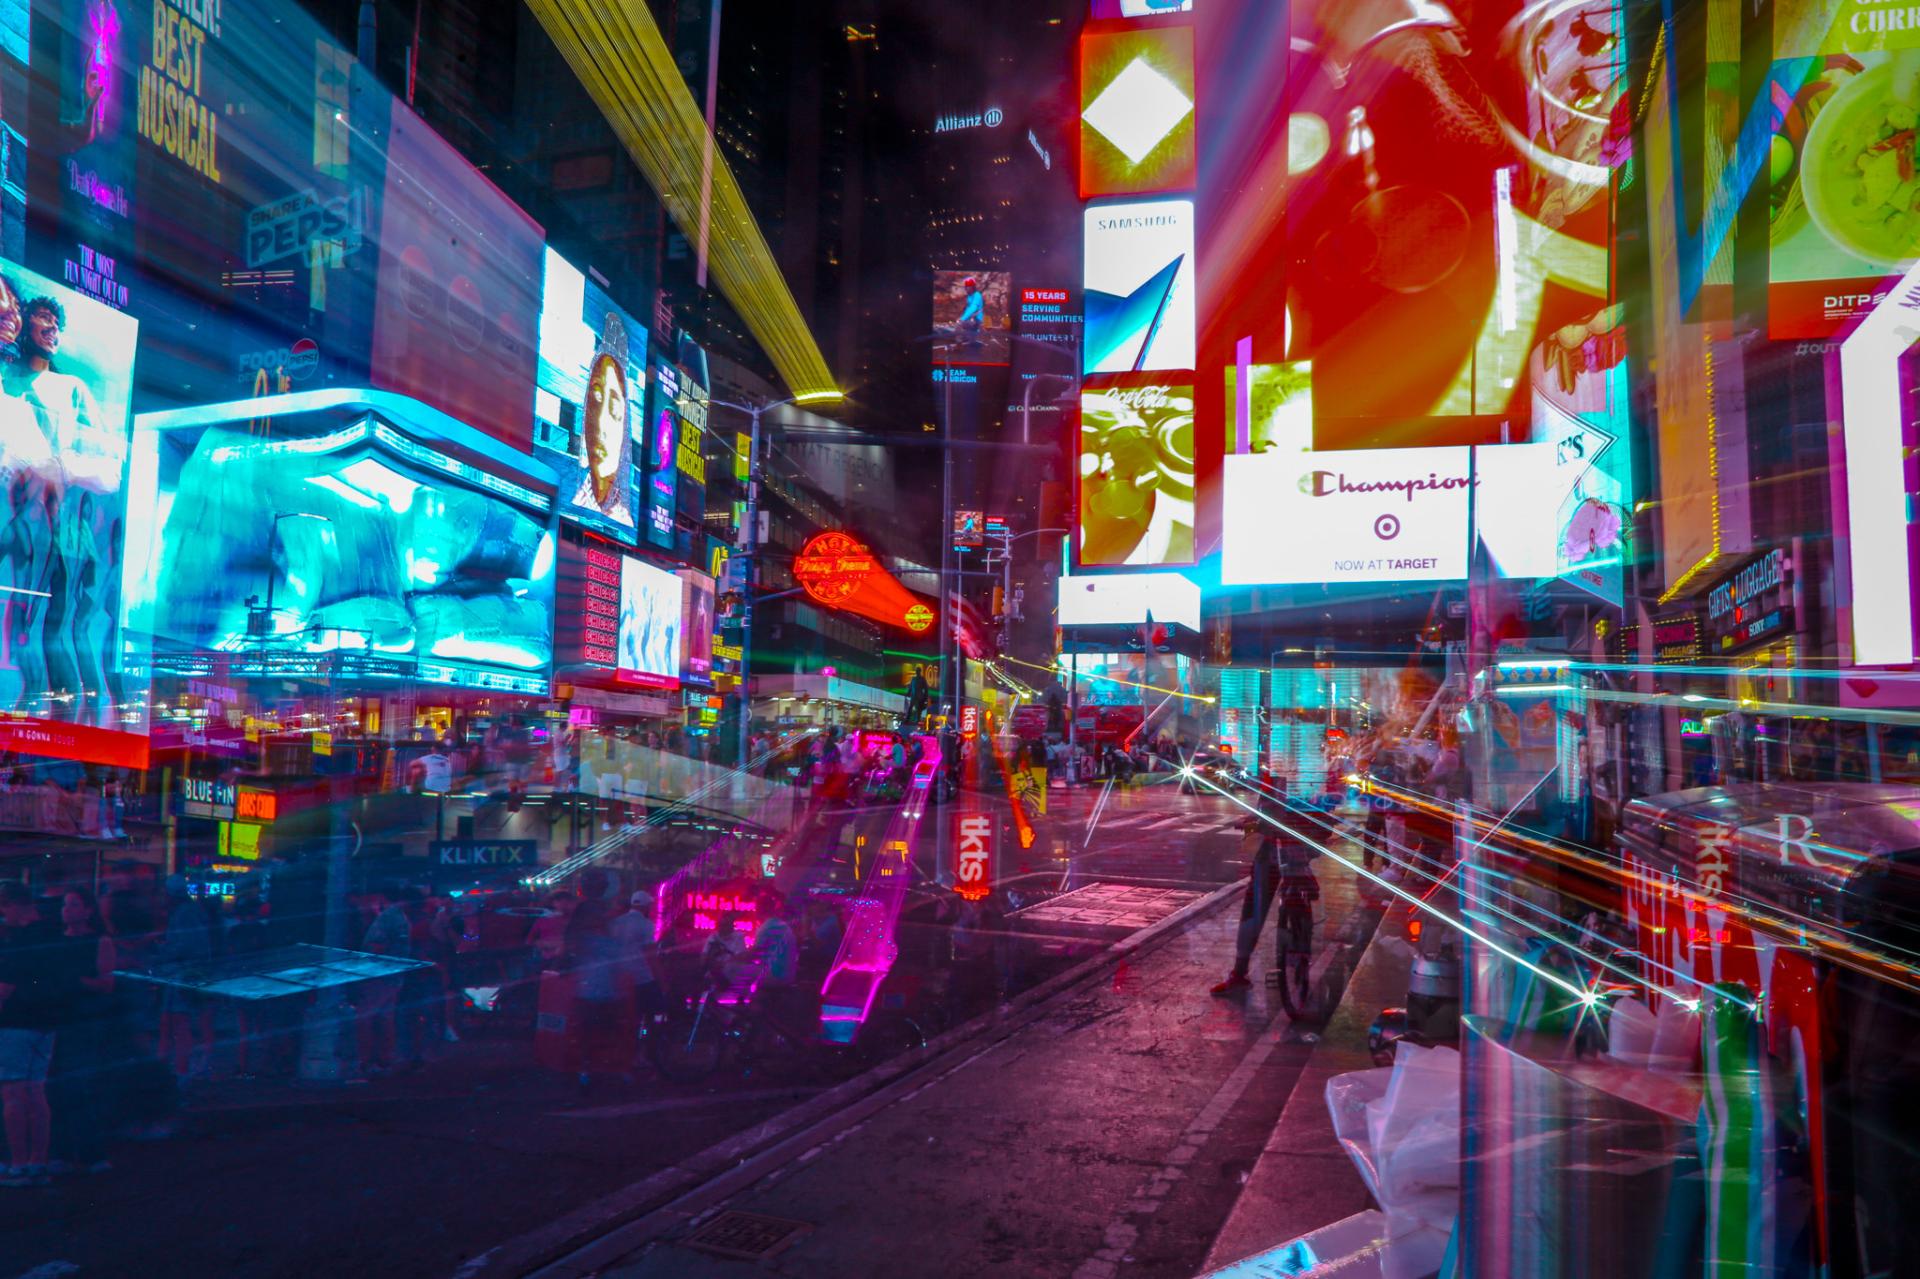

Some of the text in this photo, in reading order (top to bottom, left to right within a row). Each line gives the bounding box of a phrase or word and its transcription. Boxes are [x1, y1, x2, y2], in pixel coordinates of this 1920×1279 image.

[152, 0, 207, 96] BEST
[137, 65, 220, 183] MUSICAL
[935, 114, 982, 133] Allianz
[250, 207, 354, 262] PEPS
[1098, 215, 1177, 231] SAMSUNG
[1024, 291, 1066, 300] 15 YEARS
[1021, 304, 1061, 313] SERVING
[1021, 314, 1083, 323] COMMUNITIES
[239, 348, 290, 371] FOOD
[1105, 385, 1171, 410] Coca-Cola
[1297, 470, 1480, 502] Champion
[1334, 558, 1438, 571] NOW AT TARGET
[1709, 549, 1779, 619] GIFTS LUGGAGE
[1749, 619, 1765, 637] SONY
[964, 707, 976, 731] tkts
[26, 729, 51, 742] GONNA
[185, 778, 212, 803] BLUE
[959, 817, 991, 882] tkts
[1774, 813, 1830, 867] R
[1696, 826, 1729, 898] tkts
